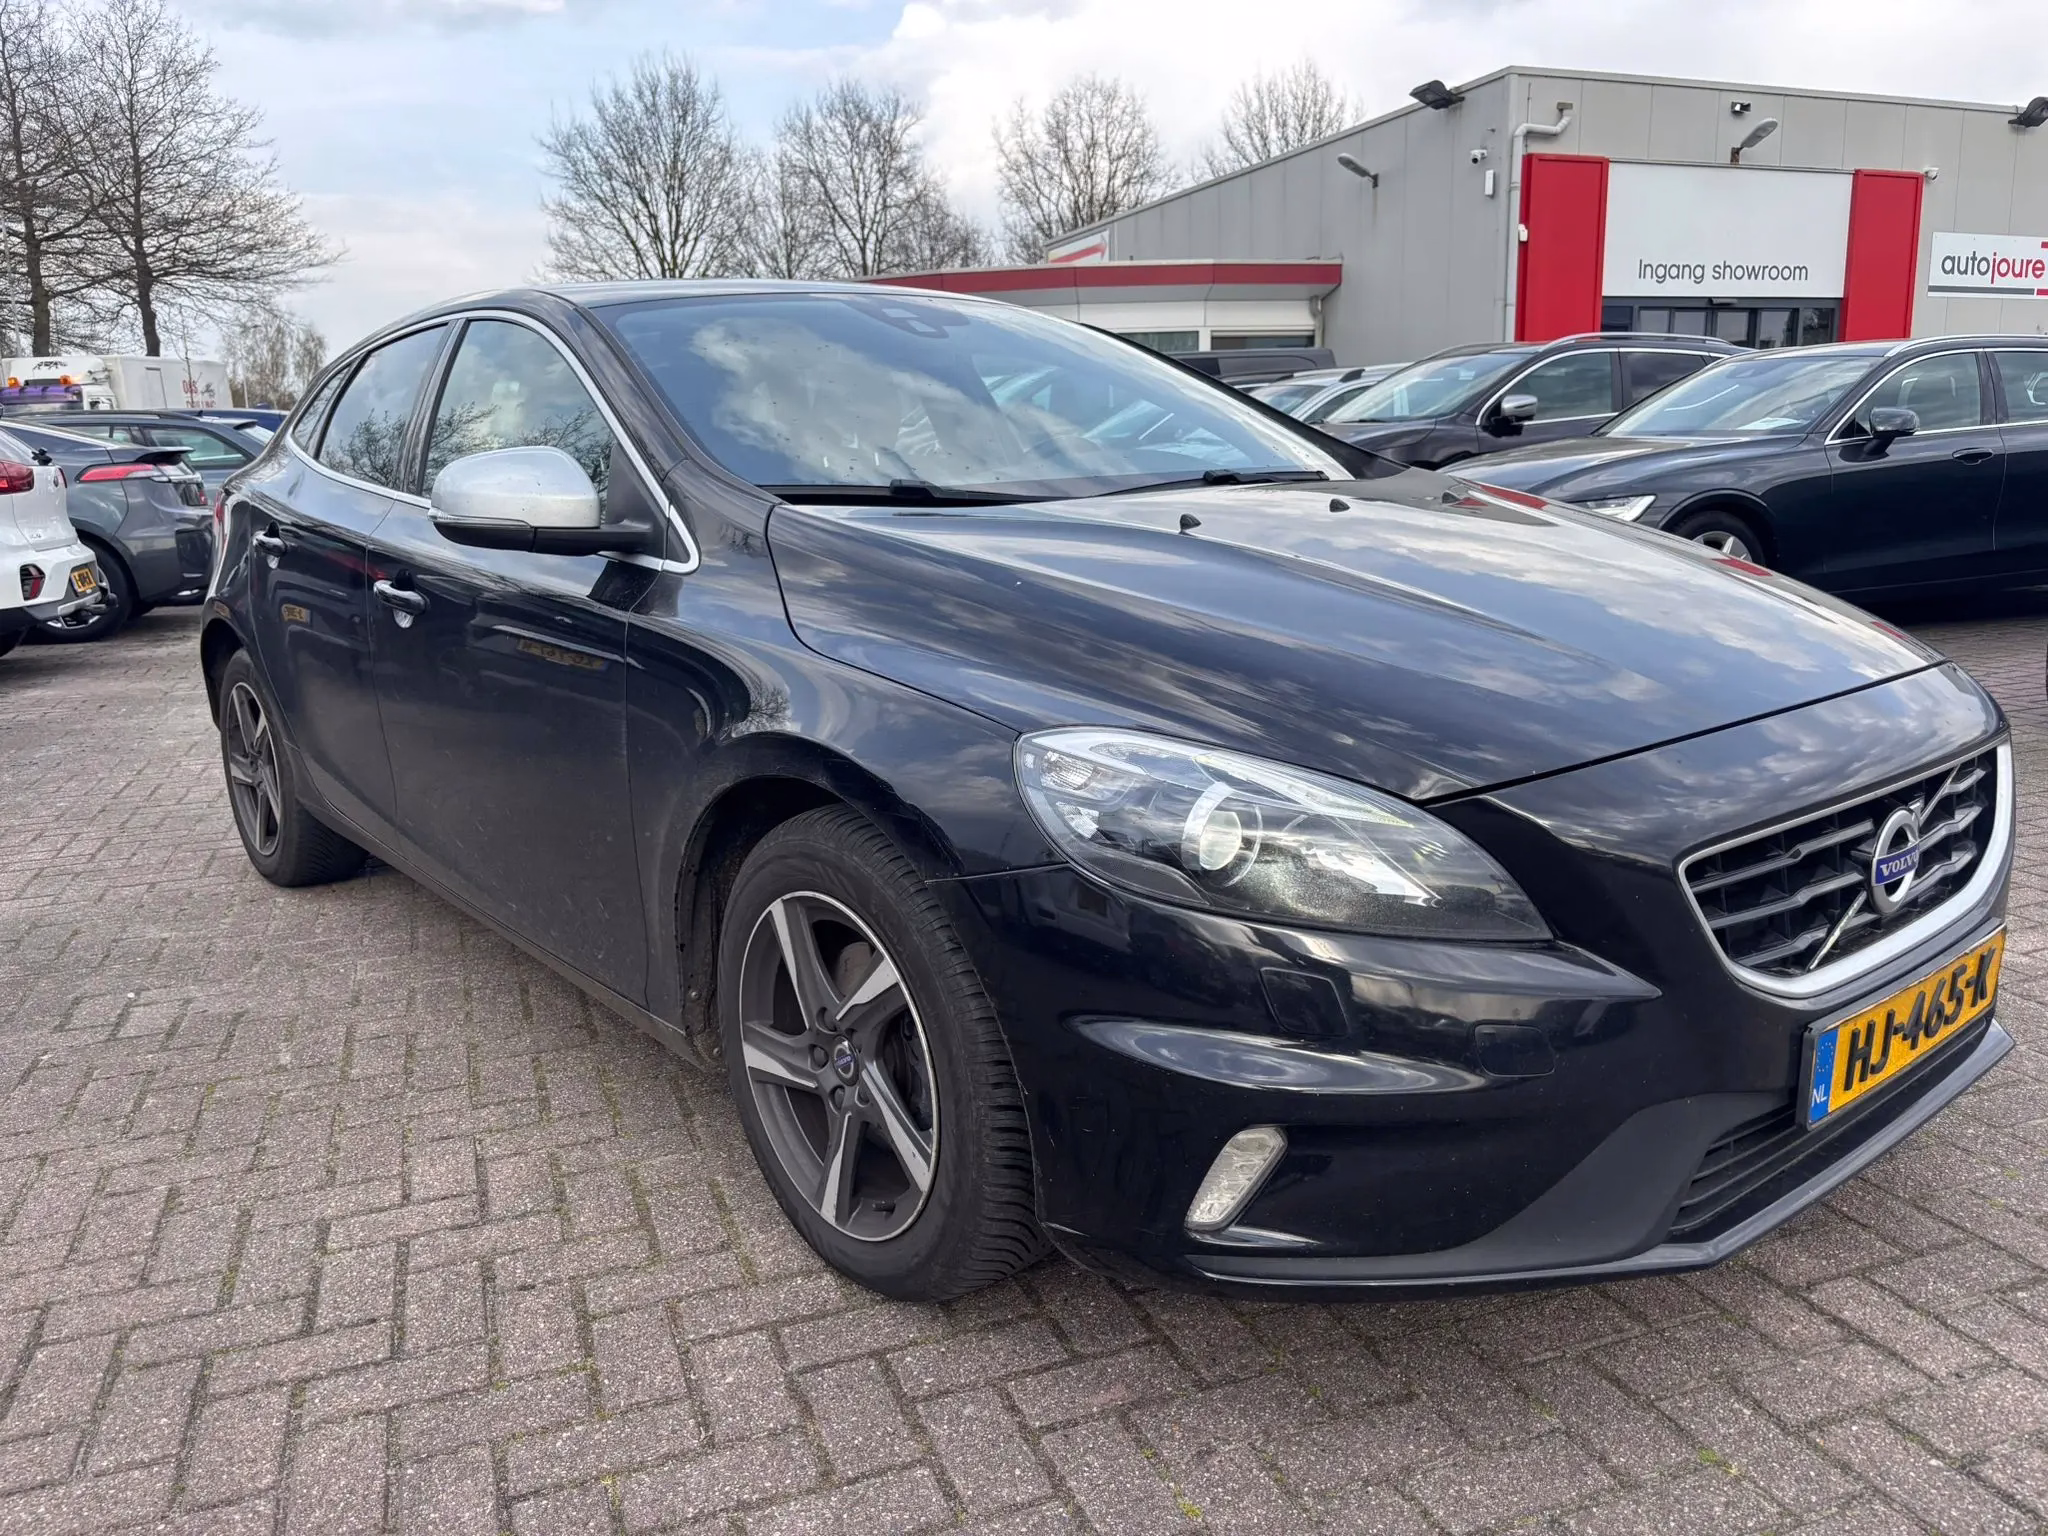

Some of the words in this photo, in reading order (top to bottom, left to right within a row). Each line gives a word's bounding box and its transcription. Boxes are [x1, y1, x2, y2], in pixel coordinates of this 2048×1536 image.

[1638, 259, 1706, 285] Ingang
[1711, 260, 1808, 281] showroom
[1941, 250, 2046, 284] autojoure
[1844, 948, 1996, 1091] HJ-465-K
[1811, 1083, 1828, 1107] NL
